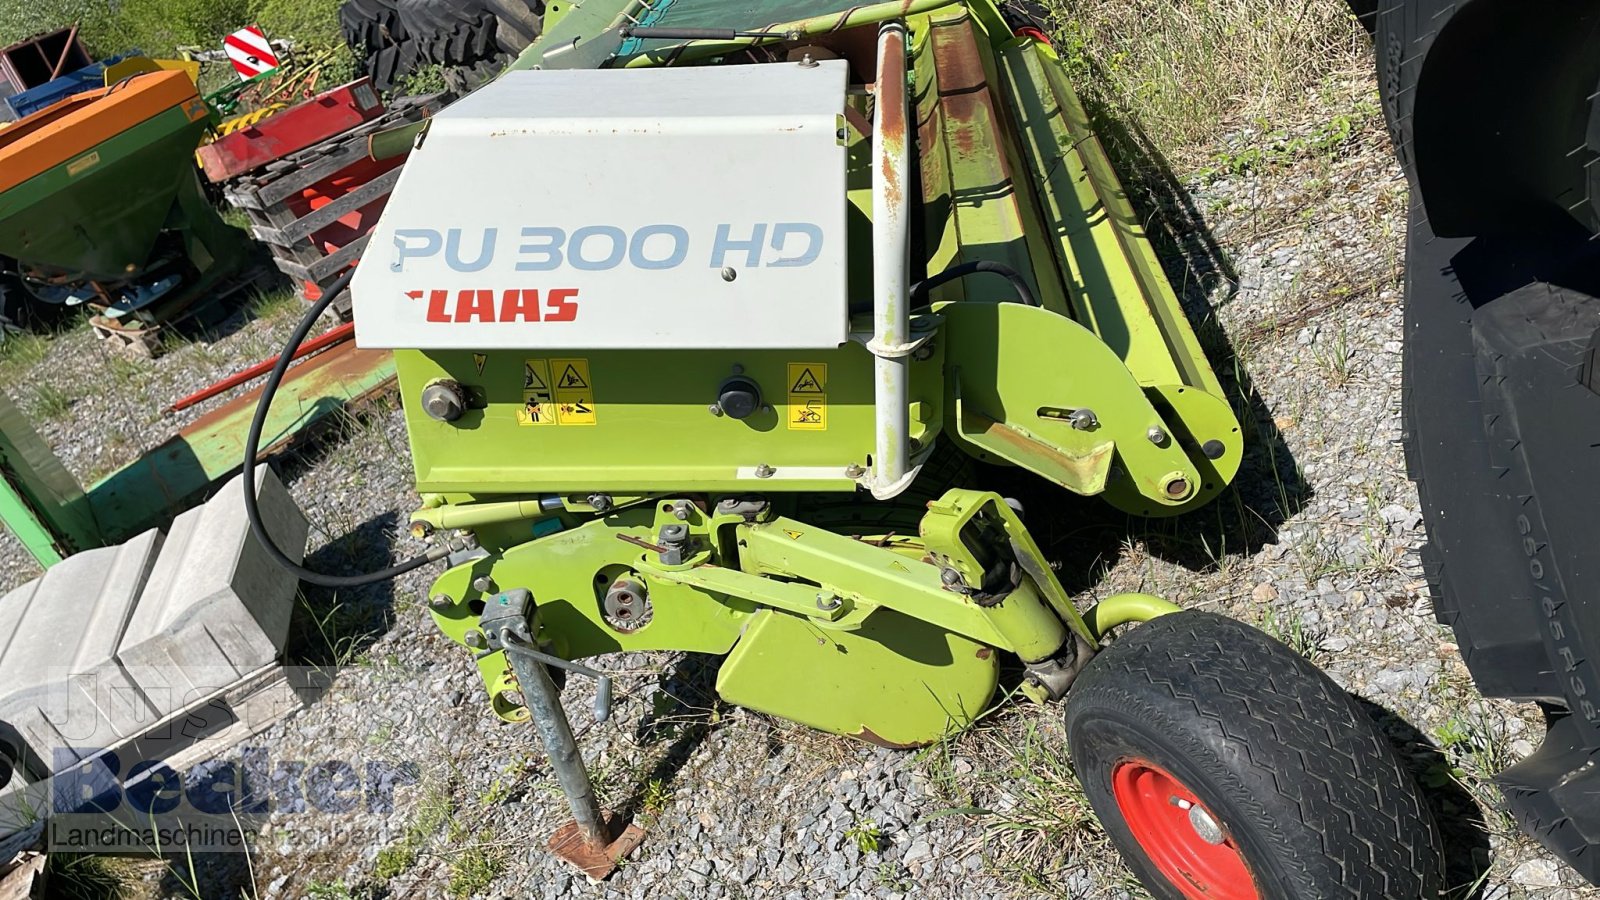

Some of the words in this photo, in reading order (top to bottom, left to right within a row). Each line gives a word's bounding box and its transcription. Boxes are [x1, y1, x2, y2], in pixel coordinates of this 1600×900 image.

[390, 228, 498, 273] PU
[515, 224, 690, 272] 300
[709, 222, 824, 268] HD
[404, 288, 580, 323] LAAS
